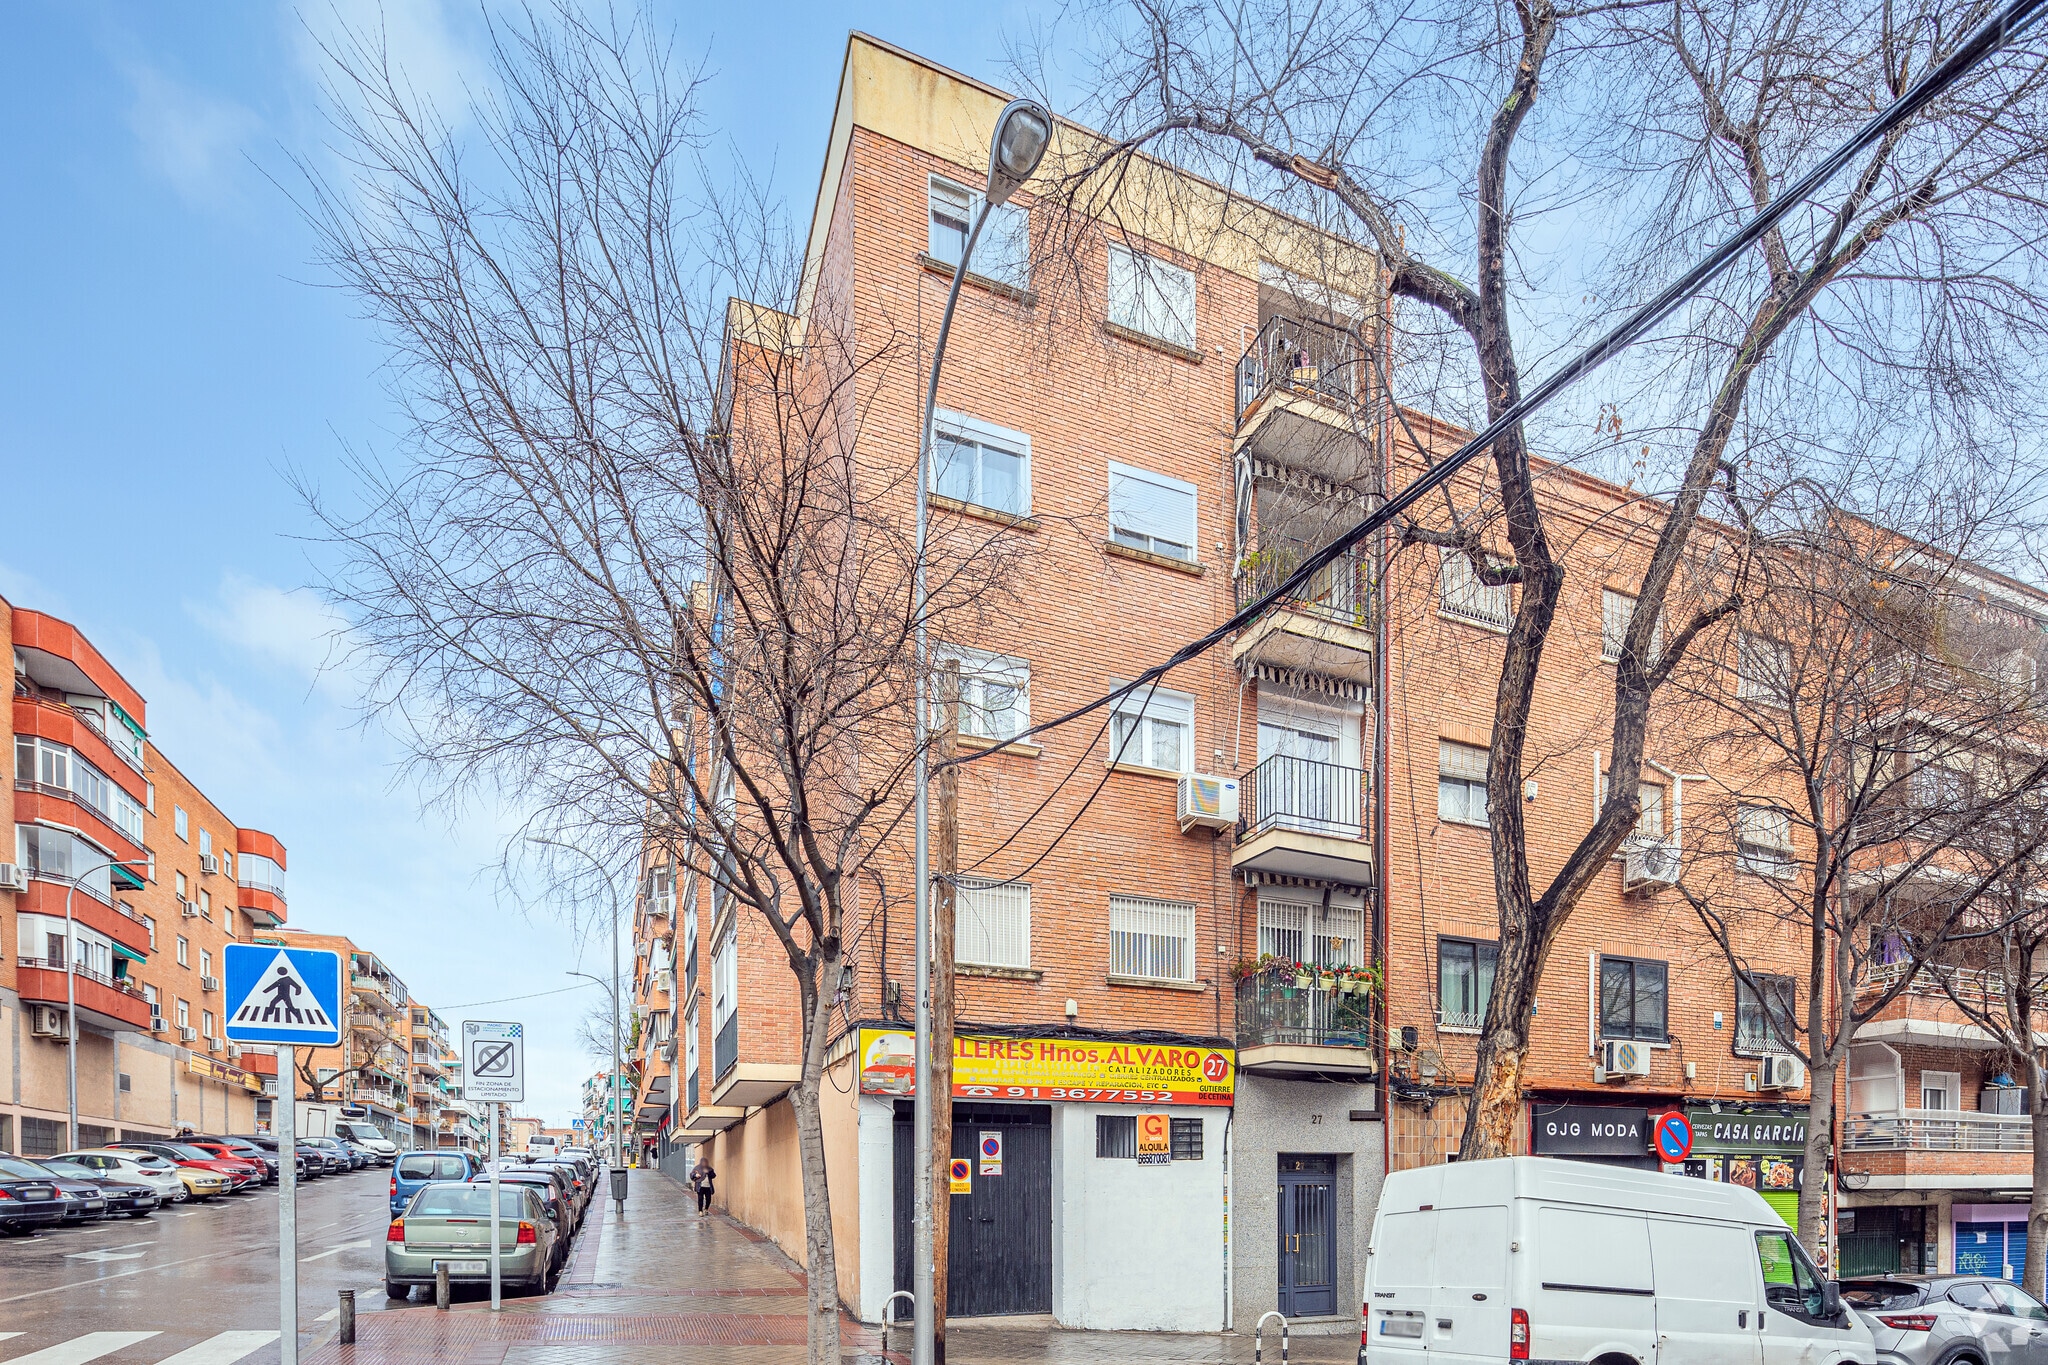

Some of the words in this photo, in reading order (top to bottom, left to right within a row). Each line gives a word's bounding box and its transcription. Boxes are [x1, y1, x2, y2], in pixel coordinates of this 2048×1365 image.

[1108, 1065, 1192, 1077] CATALIZADORES
[1206, 1059, 1225, 1077] 27
[1058, 1079, 1086, 1087] ESCAPE
[1139, 1074, 1196, 1082] CENTRALIZADOS
[1007, 1086, 1039, 1098] 91
[1050, 1088, 1173, 1101] 3677552
[1199, 1085, 1231, 1093] GUTIERRE
[1198, 1092, 1207, 1100] DE
[1207, 1093, 1231, 1101] CETINA
[1311, 1114, 1323, 1124] 27
[1546, 1122, 1580, 1136] GJG
[1591, 1123, 1639, 1137] MODA
[1713, 1122, 1749, 1140] CASA
[1754, 1121, 1804, 1142] GARCÍA
[1139, 1143, 1169, 1152] ALQUILA
